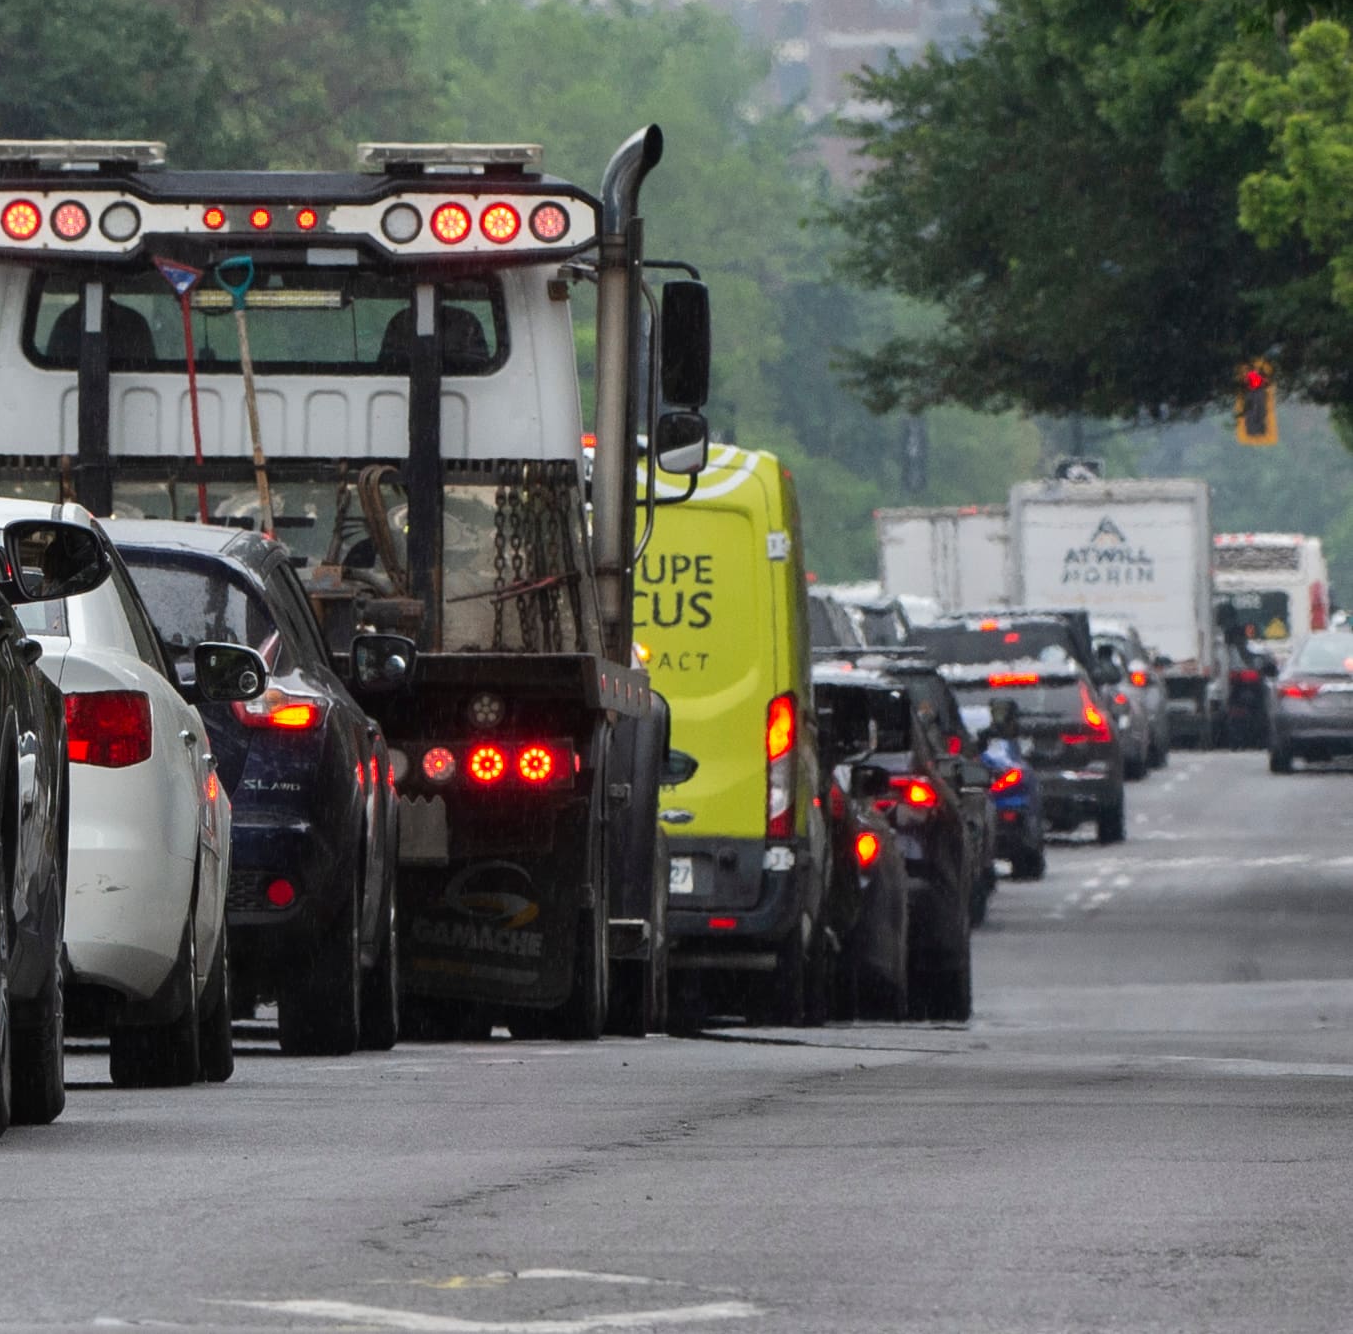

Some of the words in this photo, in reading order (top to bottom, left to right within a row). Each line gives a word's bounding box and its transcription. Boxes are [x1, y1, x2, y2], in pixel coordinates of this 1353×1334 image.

[642, 554, 714, 584] UPE
[244, 779, 269, 790] SL
[412, 916, 544, 957] GAMACHE
